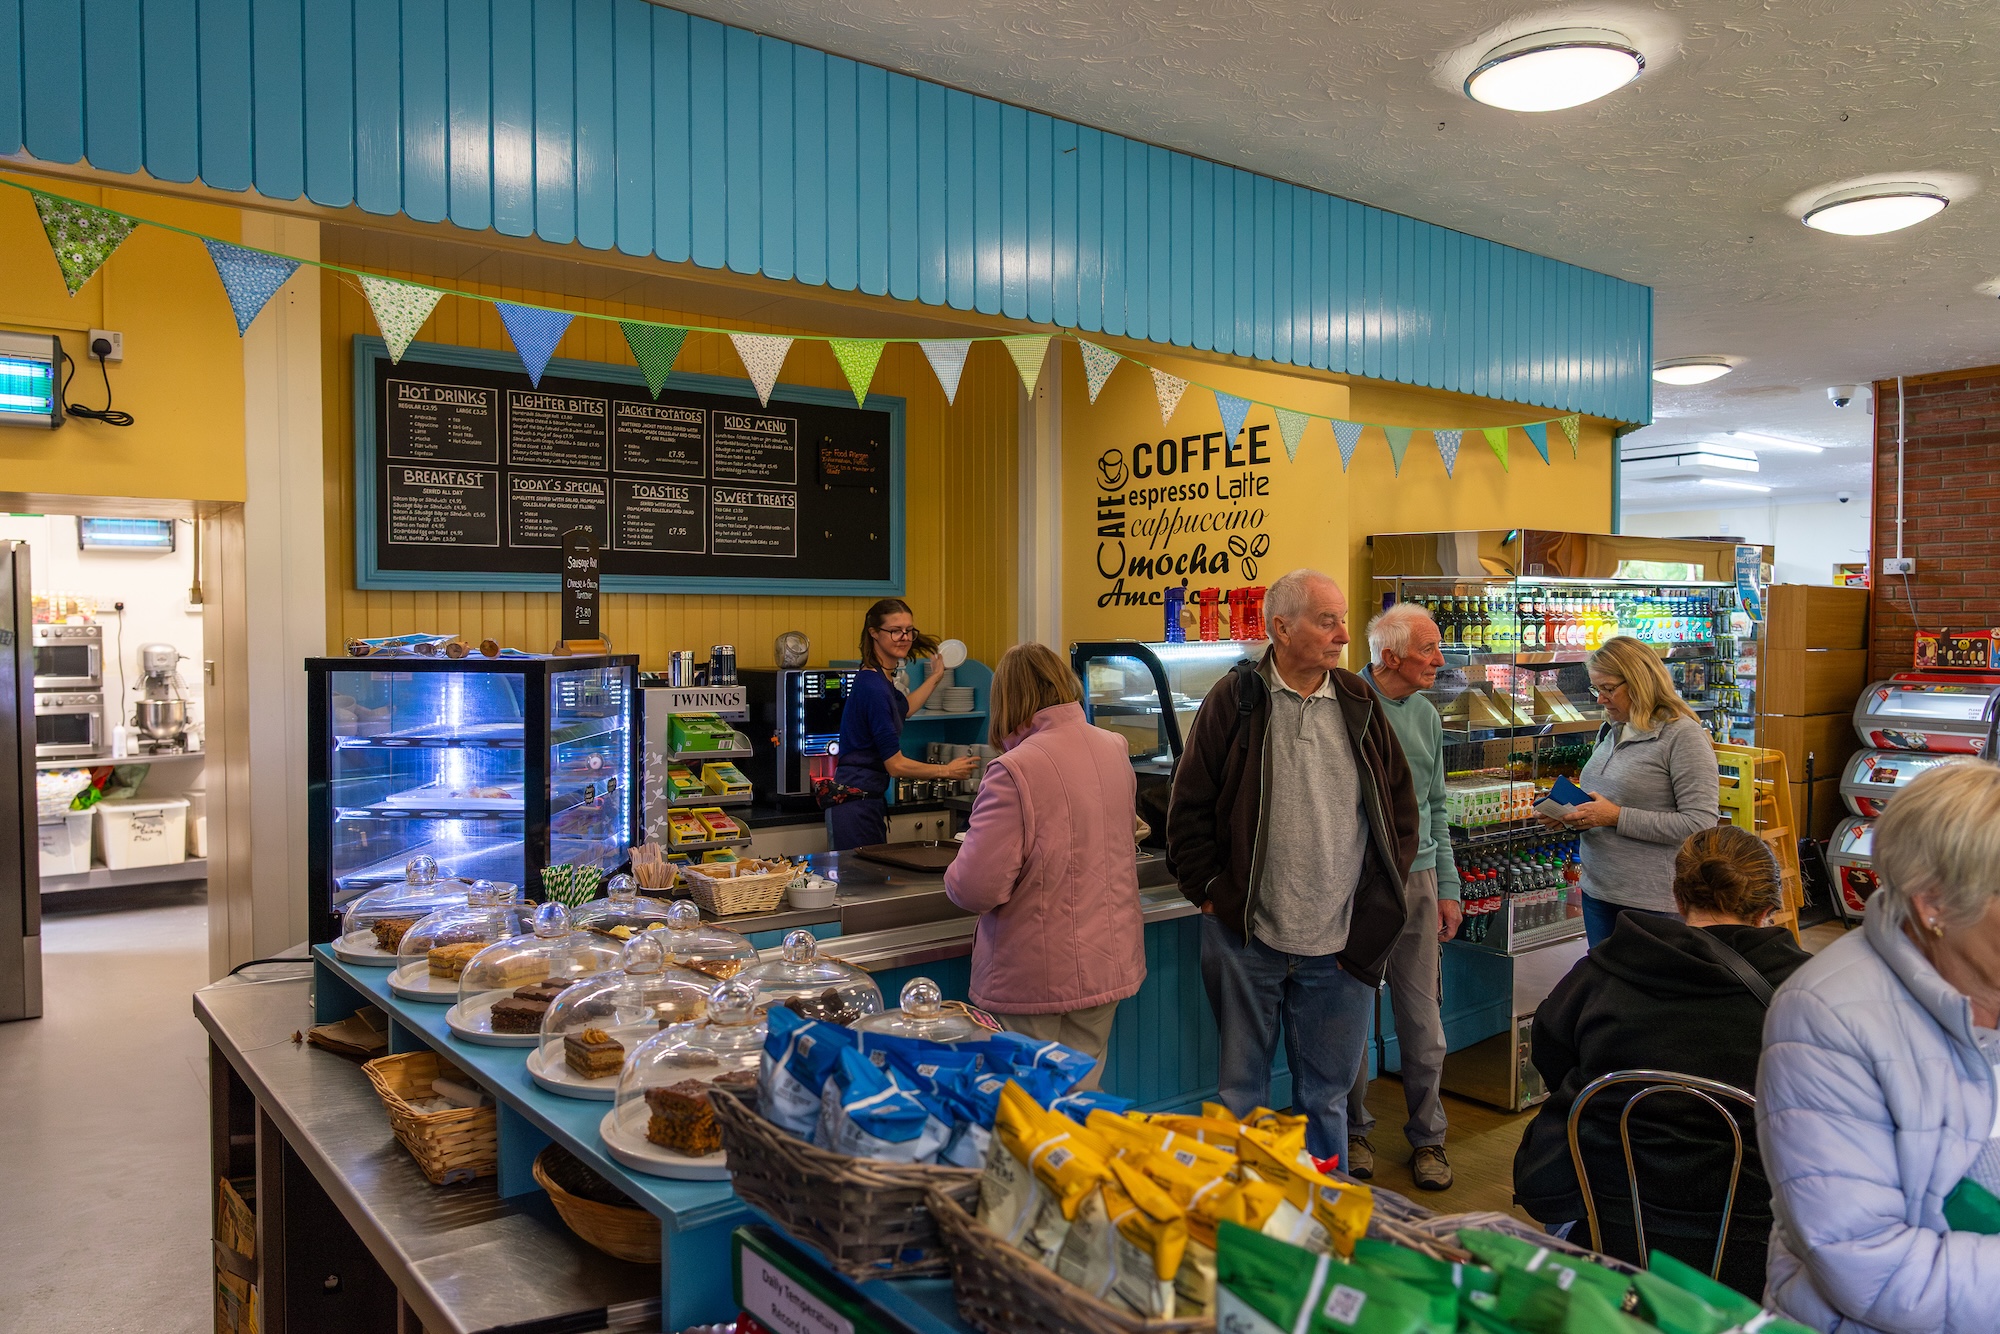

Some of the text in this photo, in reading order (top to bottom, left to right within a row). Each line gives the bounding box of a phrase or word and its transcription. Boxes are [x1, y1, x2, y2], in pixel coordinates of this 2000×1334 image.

[399, 384, 486, 405] HOT DRINKS
[512, 394, 603, 414] LIGHTER BITES
[618, 403, 701, 422] JACKET POTATOES
[725, 416, 786, 432] KIDS MENU
[669, 450, 685, 459] £7.95
[1133, 425, 1270, 479] COFFEE
[404, 469, 483, 486] BREAKFAST
[513, 477, 604, 493] TODAY'S SPECIAL
[632, 483, 688, 499] TOASTIES
[715, 490, 794, 506] SWEET TREATS
[1129, 472, 1270, 510] espresso Latte
[669, 527, 686, 536] £7.95
[1131, 501, 1270, 550] cappuccino
[1097, 494, 1126, 580] CAFE
[568, 556, 589, 572] Sausage
[1128, 543, 1230, 580] mocha
[567, 578, 582, 589] Cheese
[575, 606, 591, 619] £3.80
[672, 693, 740, 707] TWININGS
[762, 1268, 838, 1334] Daily Temperature
